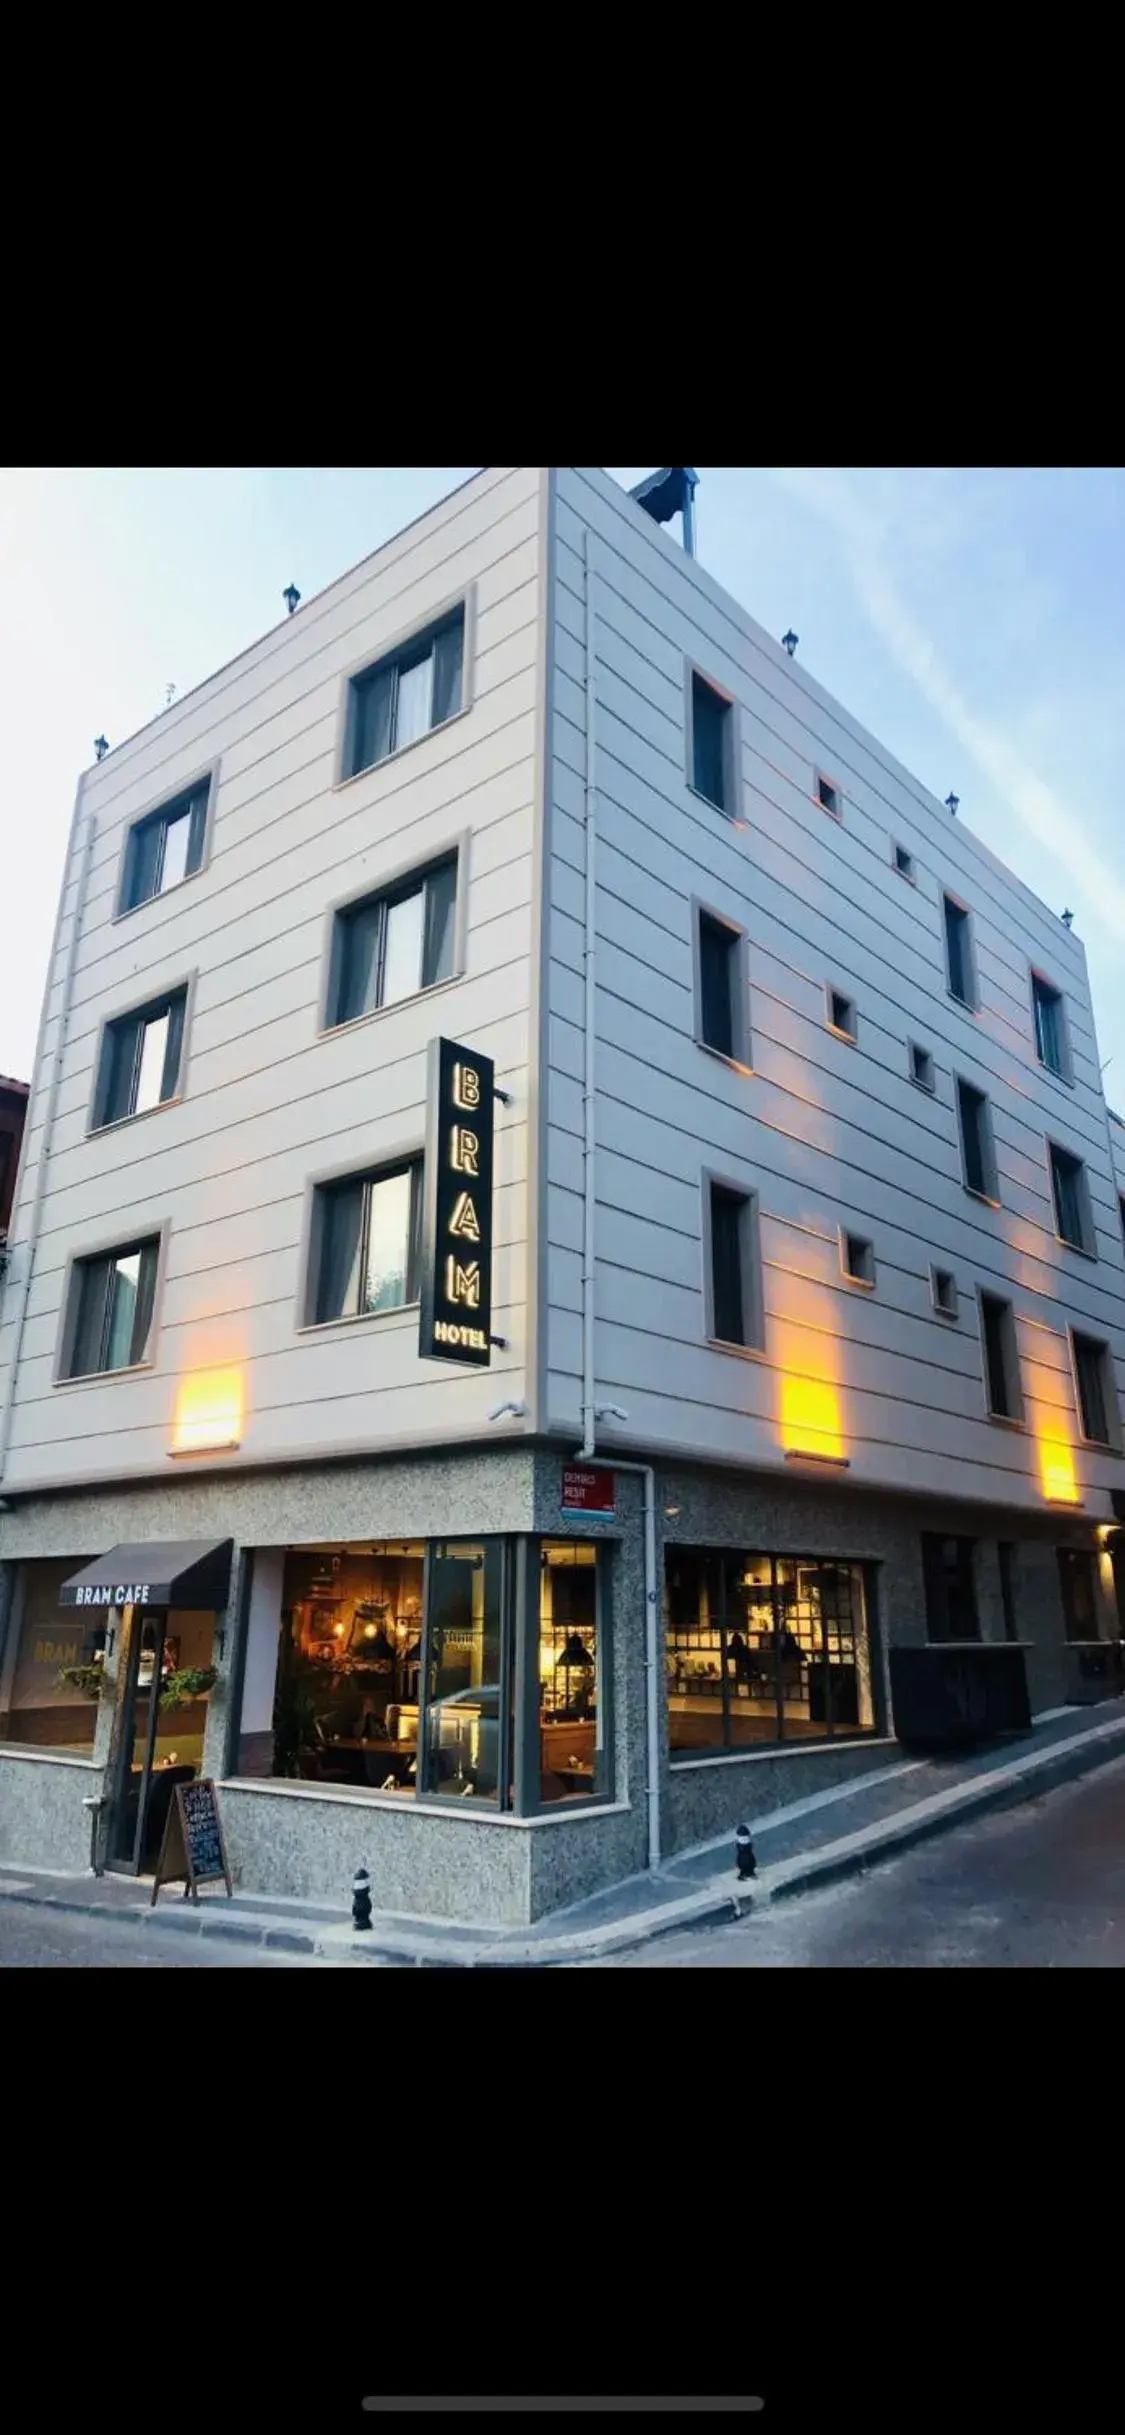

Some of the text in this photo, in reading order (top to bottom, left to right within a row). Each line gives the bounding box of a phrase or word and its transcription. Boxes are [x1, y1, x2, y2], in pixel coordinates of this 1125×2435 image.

[446, 1061, 480, 1308] BRAM
[434, 1320, 488, 1350] HOTEL
[75, 1584, 150, 1605] BRAM CAFE
